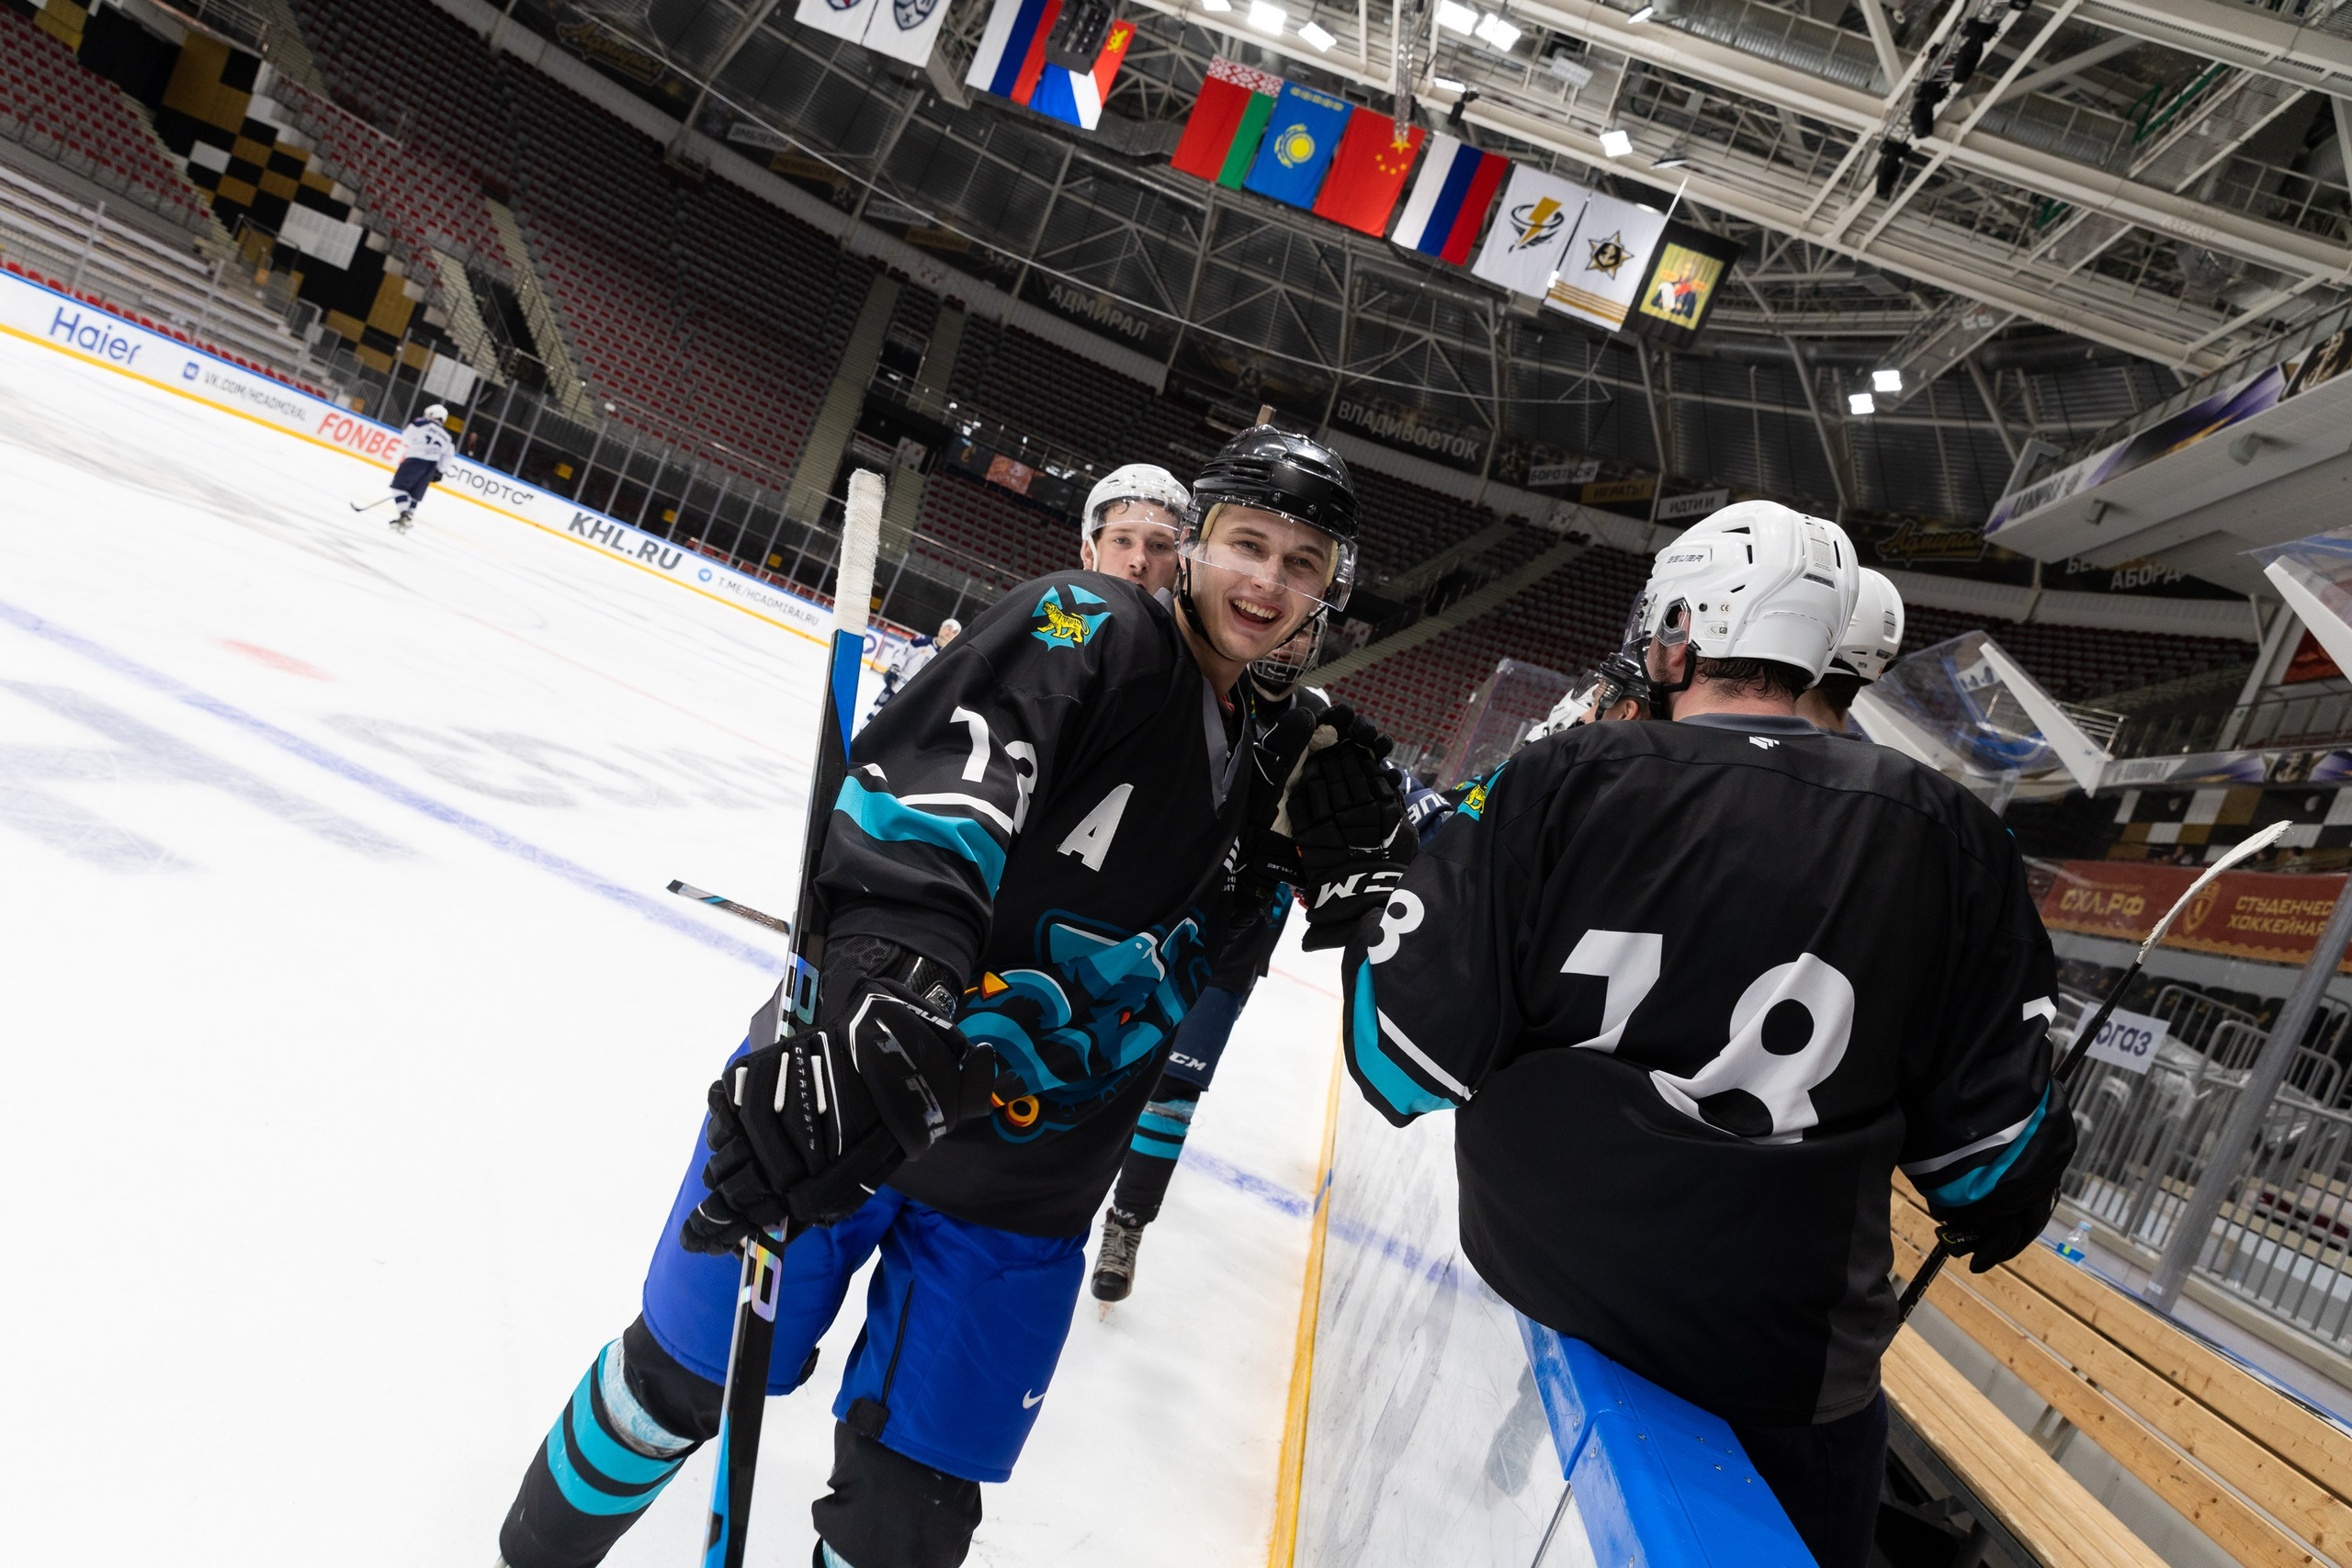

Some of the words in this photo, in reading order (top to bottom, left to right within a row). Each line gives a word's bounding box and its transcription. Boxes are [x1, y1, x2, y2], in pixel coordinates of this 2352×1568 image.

[50, 306, 142, 365] Haier
[1047, 284, 1149, 342] АДМИРАЛ
[1337, 400, 1481, 462] ВЛАДИВОСТОК
[567, 511, 683, 571] KHL.RU
[1057, 783, 1135, 872] A
[1313, 872, 1405, 909] CM
[1168, 1051, 1207, 1072] CM
[2088, 1020, 2153, 1057] огаз
